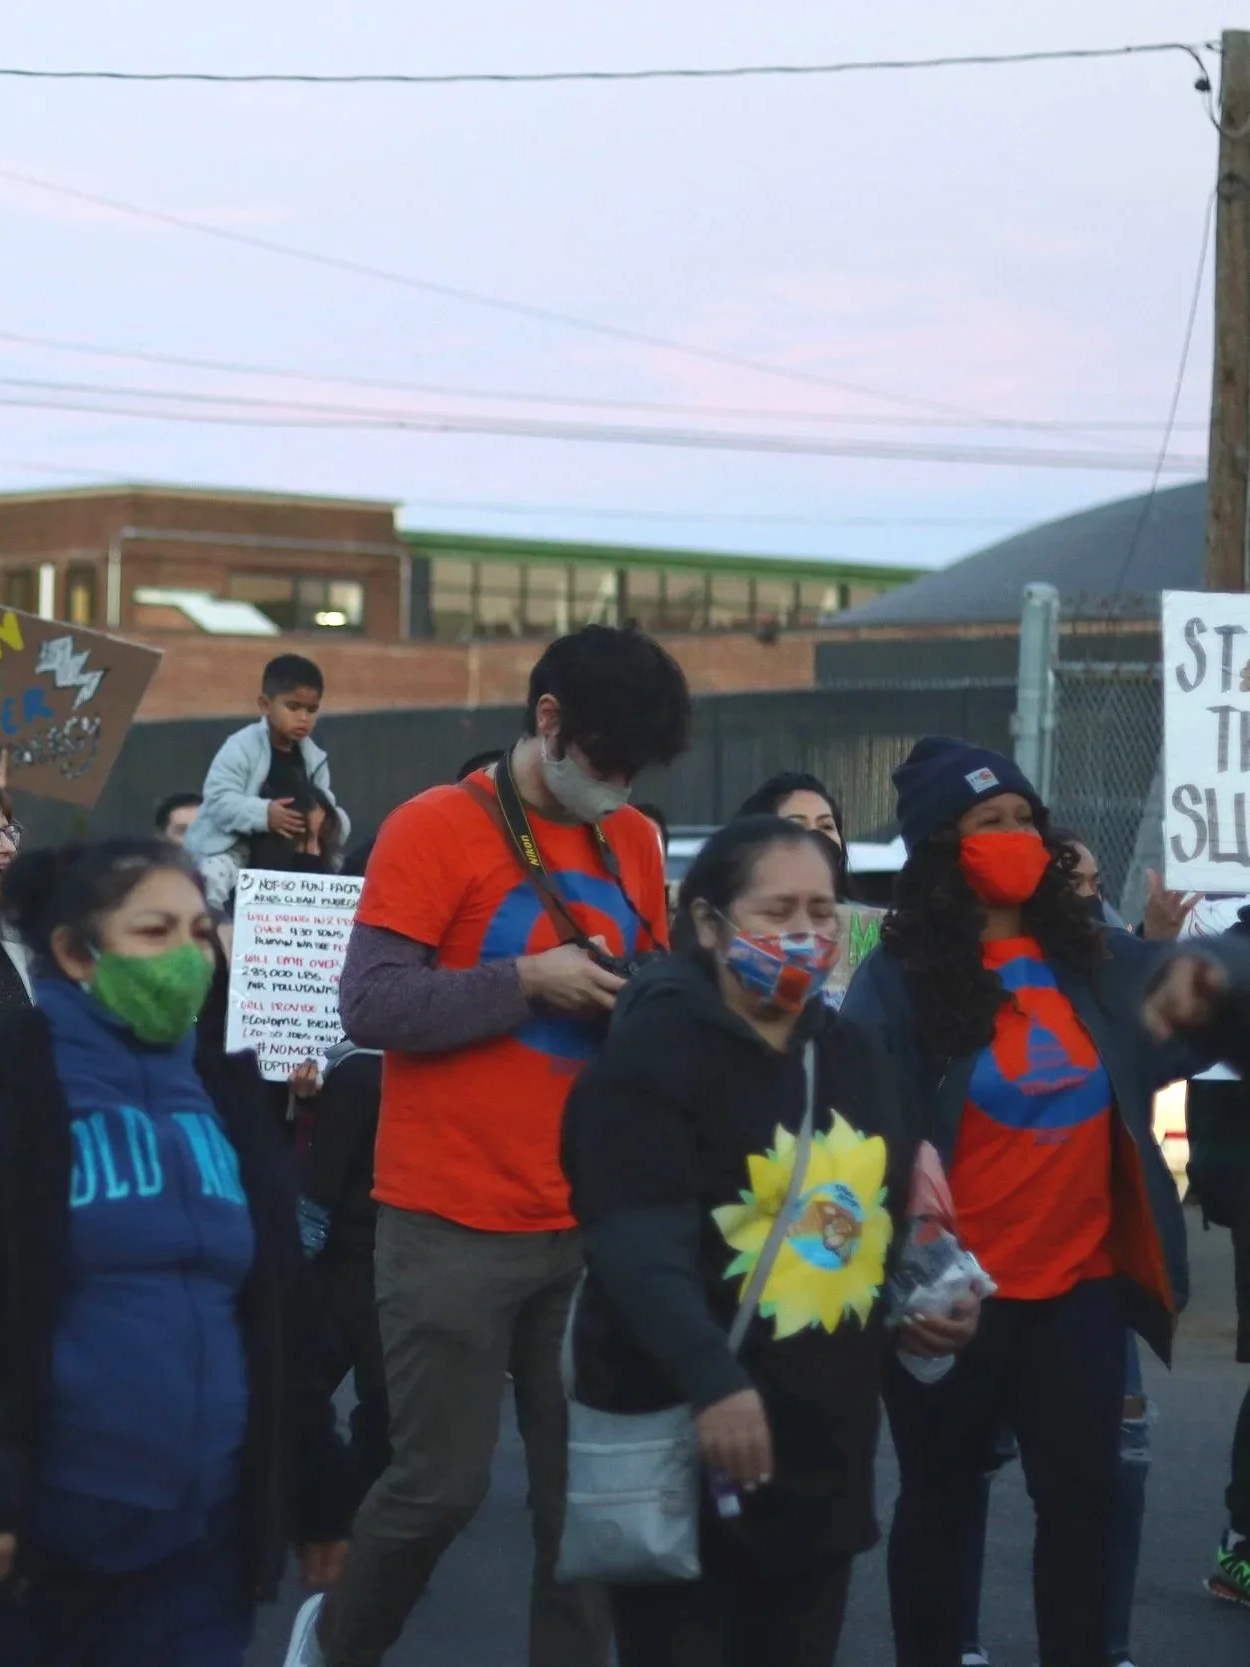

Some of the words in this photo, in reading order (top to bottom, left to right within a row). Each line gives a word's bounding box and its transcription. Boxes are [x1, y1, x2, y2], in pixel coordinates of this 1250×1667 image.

[520, 834, 540, 867] Nikon
[301, 880, 324, 892] FUN
[330, 883, 361, 894] FACTS
[284, 896, 316, 904] CLEAN
[254, 925, 282, 934] OVER
[289, 927, 312, 936] 430
[244, 953, 269, 964] WILL
[309, 959, 339, 969] OVER
[247, 981, 266, 990] AIR
[272, 982, 340, 995] POLLUTANTS
[272, 1001, 317, 1013] PROVIDE
[242, 1014, 302, 1027] ECONOMIC
